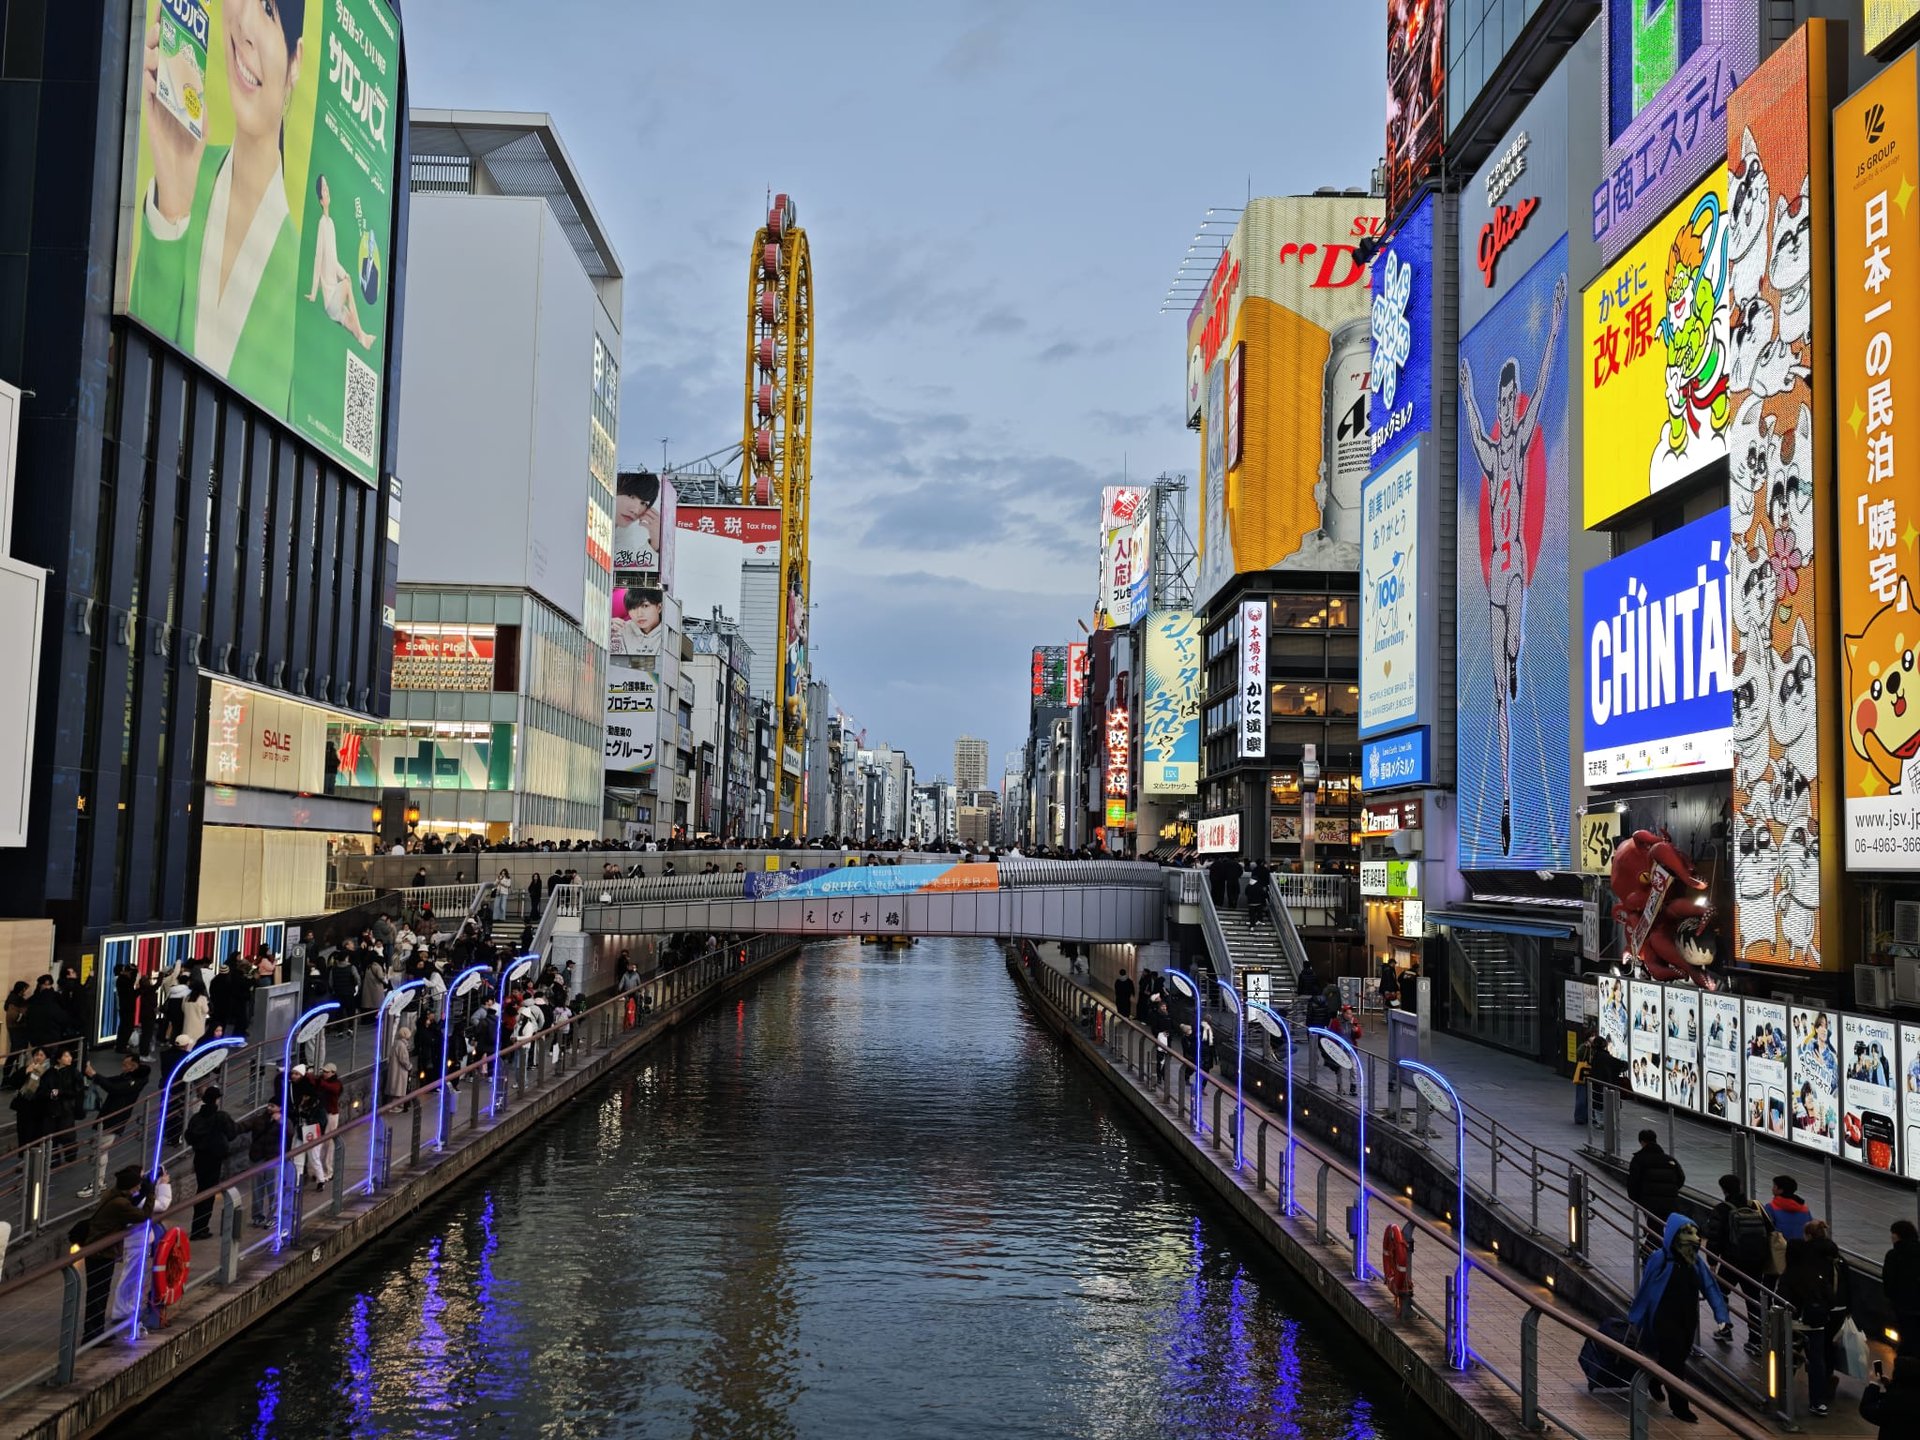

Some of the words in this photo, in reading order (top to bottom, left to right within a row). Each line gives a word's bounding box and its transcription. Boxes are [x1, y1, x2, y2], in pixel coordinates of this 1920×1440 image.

[166, 0, 208, 48] ロンパス
[328, 31, 388, 154] サロンパス
[1855, 162, 1866, 179] JS
[1866, 140, 1897, 171] GROUP
[1477, 196, 1538, 288] Glico
[1598, 260, 1649, 326] かぜに
[1592, 291, 1655, 390] 改源
[697, 516, 742, 535] 免税
[746, 523, 759, 535] Tax
[760, 523, 777, 535] Free
[1372, 508, 1407, 551] ありがとう
[1500, 471, 1511, 572] グリコ
[405, 641, 440, 652] Scenic
[1248, 625, 1262, 677] 本場の味
[606, 696, 654, 711] プロデュース
[1246, 681, 1263, 753] かに道楽
[263, 730, 291, 751] SALE
[606, 725, 632, 737] 動産業の
[1105, 707, 1129, 796] 大阪王将
[1380, 757, 1415, 780] 雪印メグミルク
[1368, 812, 1400, 832] ZETTERIA
[806, 909, 900, 927] えびす橋
[1904, 1031, 1917, 1044] ねえ
